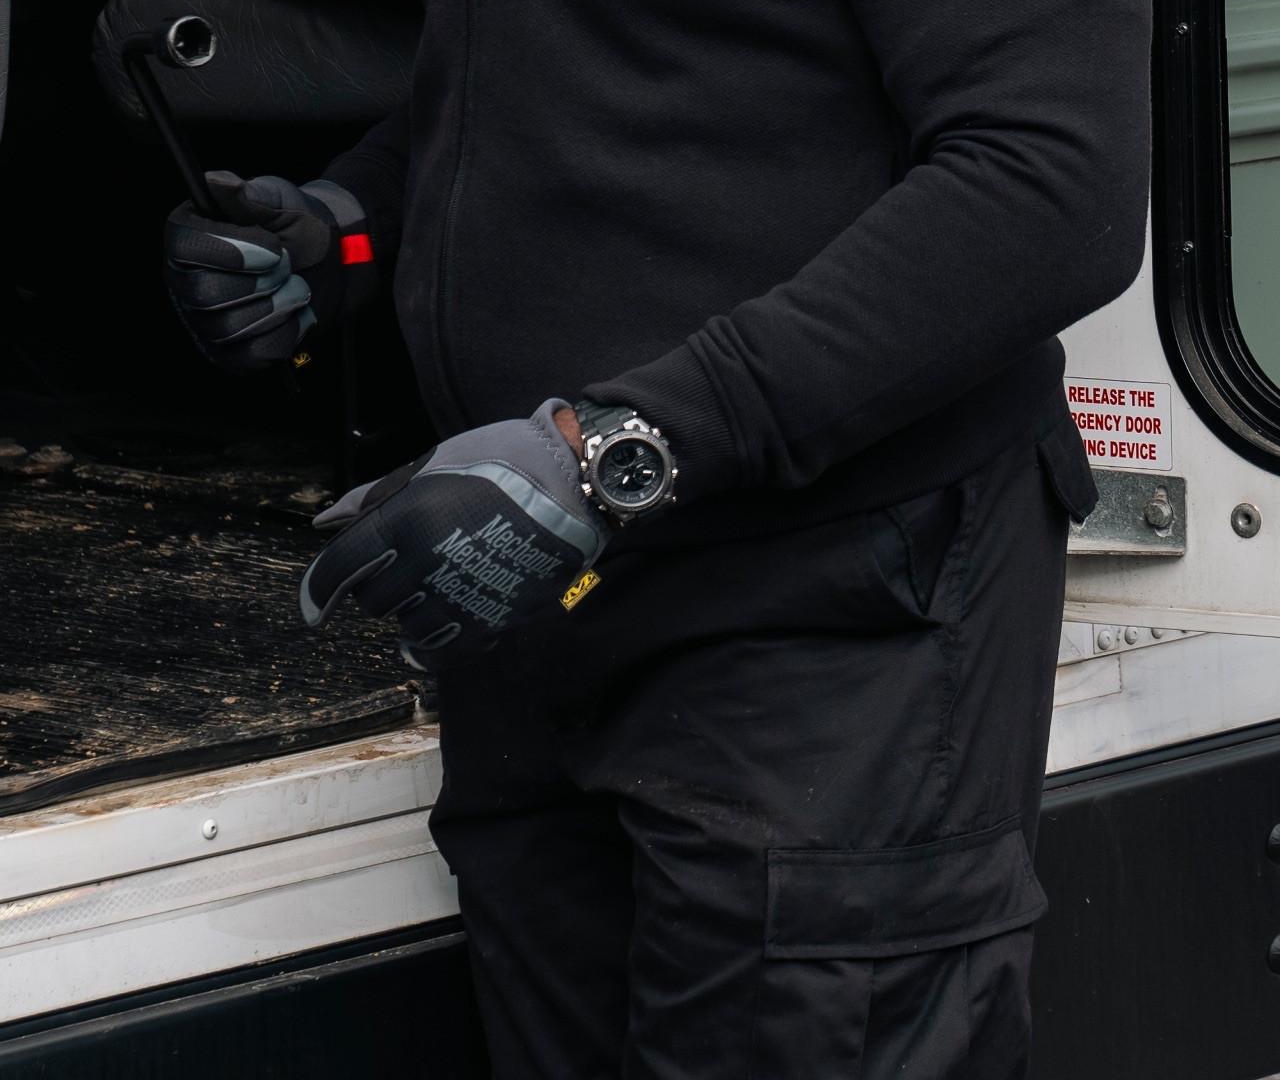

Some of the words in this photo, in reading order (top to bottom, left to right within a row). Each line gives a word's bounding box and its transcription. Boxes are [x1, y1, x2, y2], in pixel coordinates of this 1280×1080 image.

[1069, 386, 1126, 406] RELEASE
[1129, 390, 1155, 407] THE
[1126, 416, 1161, 434] DOOR
[1110, 441, 1157, 460] DEVICE
